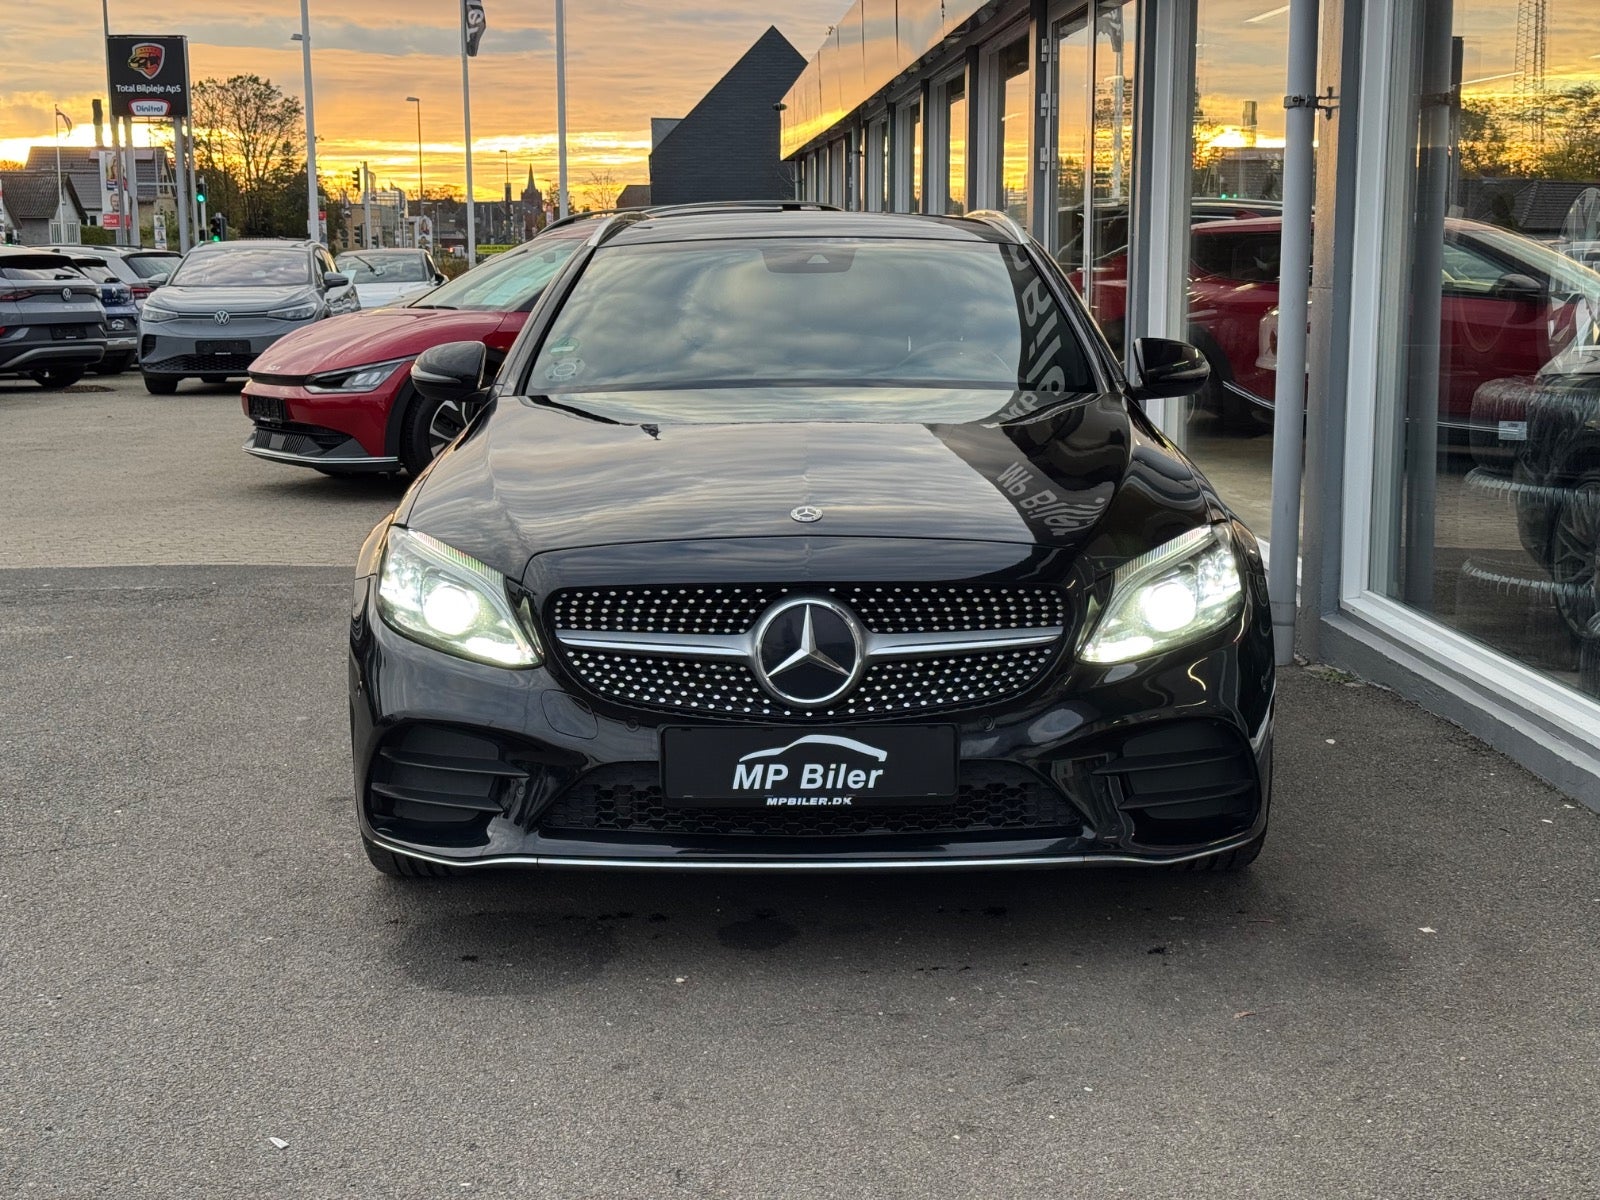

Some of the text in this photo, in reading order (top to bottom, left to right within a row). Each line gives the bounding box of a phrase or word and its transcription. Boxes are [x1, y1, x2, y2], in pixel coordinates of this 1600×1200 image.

[116, 84, 181, 94] Total Bilpleje ApS
[732, 763, 884, 790] MP Biler
[766, 797, 852, 806] MPBILER.DK
